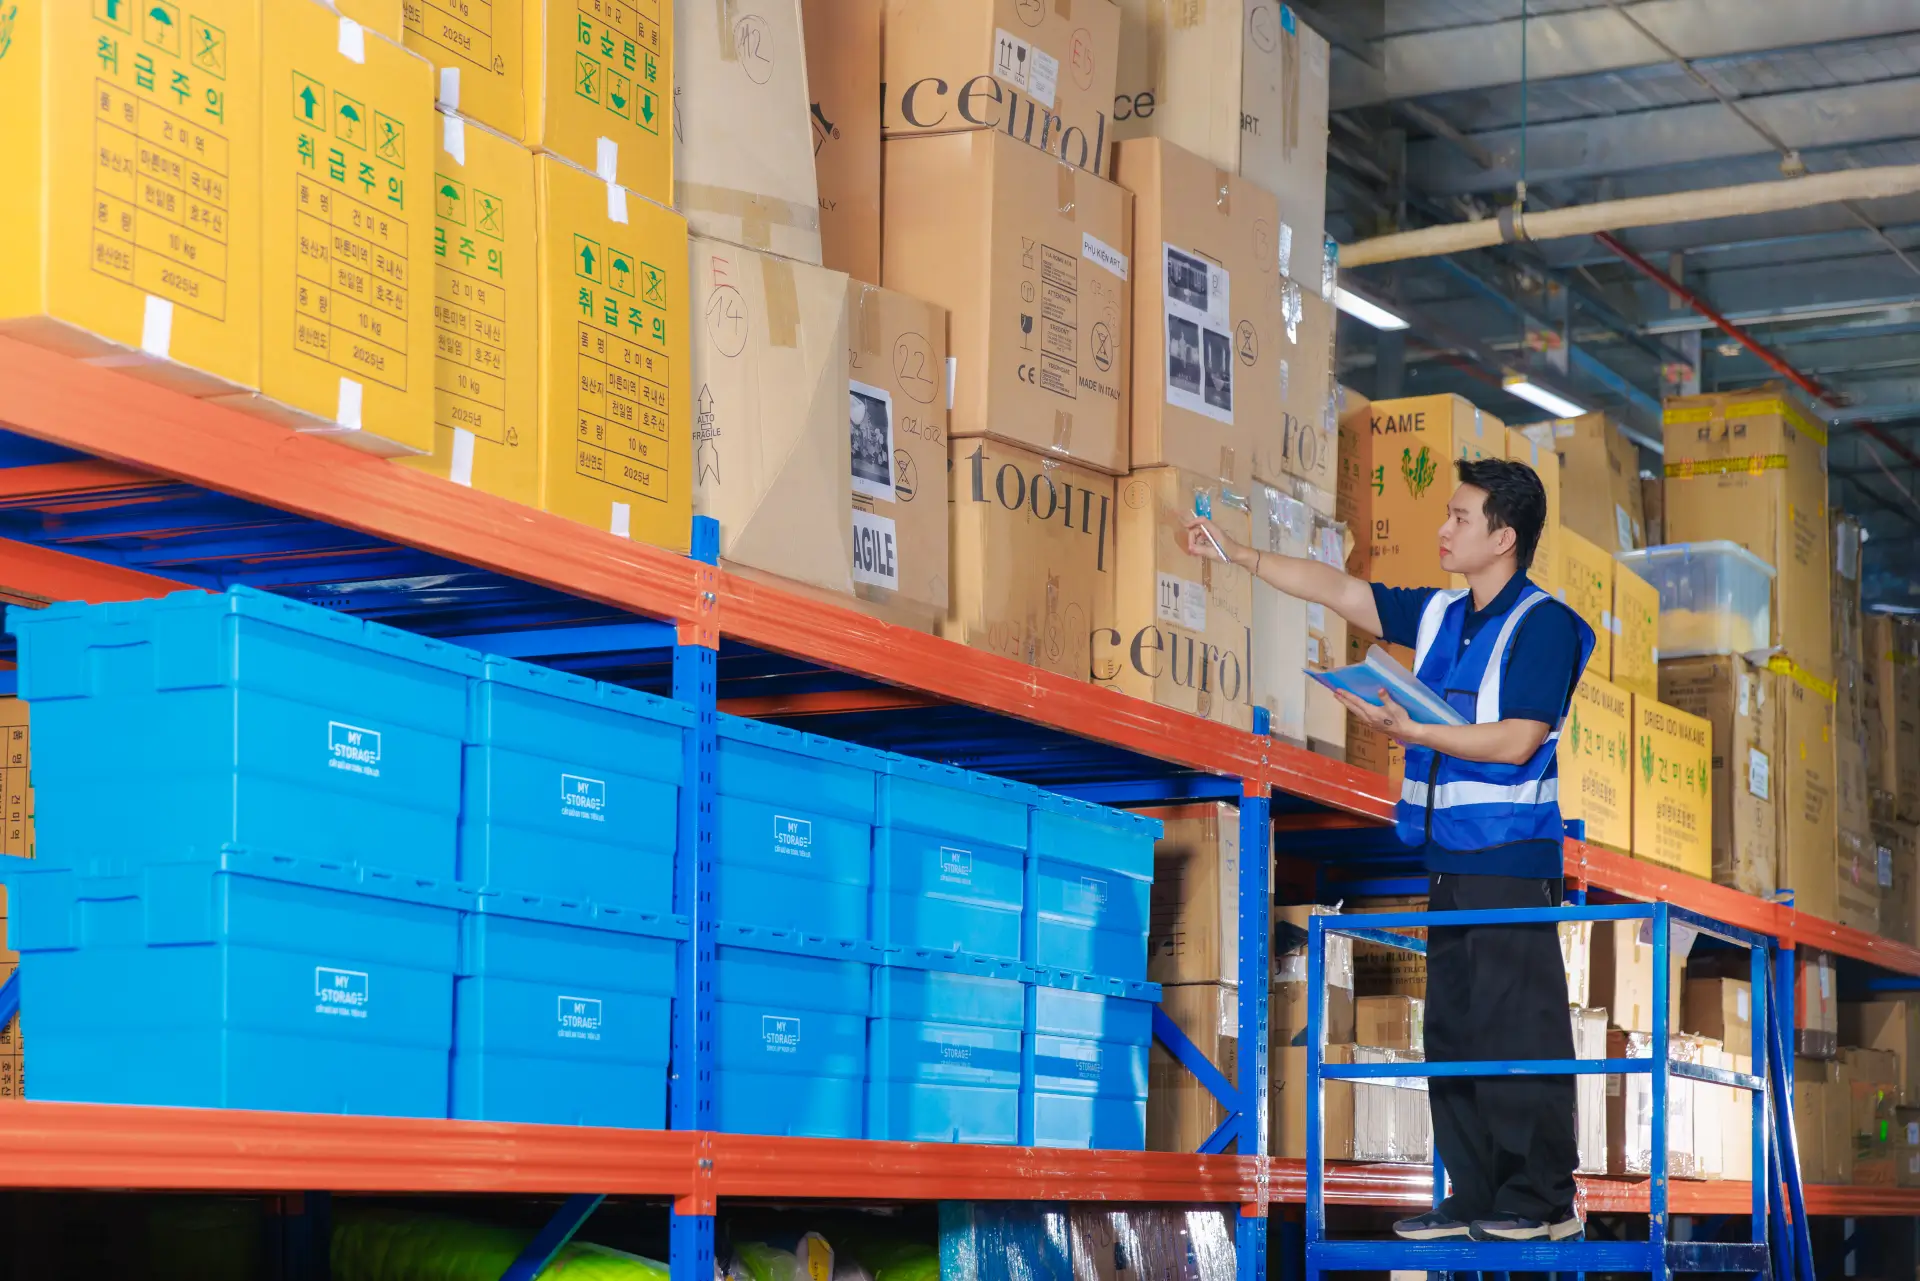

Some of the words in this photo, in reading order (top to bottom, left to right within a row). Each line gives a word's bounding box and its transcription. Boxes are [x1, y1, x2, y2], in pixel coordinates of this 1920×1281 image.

[443, 25, 471, 51] 2025년
[578, 14, 657, 83] 취급주의
[97, 36, 224, 125] 취급주의
[100, 147, 133, 178] 원산지
[298, 133, 404, 211] 취급주의
[191, 172, 222, 201] 국내산
[190, 205, 222, 234] 호주산
[169, 234, 181, 251] 10
[183, 240, 196, 260] kg
[300, 236, 329, 263] 원산지
[375, 254, 403, 281] 국내산
[712, 256, 735, 288] E
[162, 269, 199, 298] 2025년
[376, 285, 403, 310] 호주산
[358, 313, 369, 329] 10
[371, 318, 382, 336] kg
[578, 287, 666, 347] 취급주의
[706, 296, 744, 336] 14
[474, 319, 501, 343] 국내산
[352, 345, 385, 371] 2025년
[474, 347, 501, 370] 호주산
[900, 344, 933, 384] 22
[458, 374, 468, 389] 10
[470, 379, 480, 395] kg
[581, 375, 605, 399] 원산지
[609, 373, 637, 396] 마른미역
[642, 385, 665, 407] 국내산
[1079, 376, 1098, 392] MADE
[1105, 385, 1121, 401] ITALY
[451, 406, 482, 428] 2025년
[611, 400, 633, 421] 천일염
[642, 412, 665, 433] 호주산
[697, 414, 715, 424] ALTO
[692, 428, 721, 440] FRAGILE
[628, 437, 637, 451] 10
[639, 440, 648, 456] kg
[579, 451, 603, 471] 생산연도
[623, 465, 650, 487] 2025년
[347, 731, 362, 746] MY
[334, 743, 376, 764] STORAGE
[577, 782, 589, 795] MY
[566, 794, 601, 811] STORAGE
[787, 822, 798, 833] MY
[778, 832, 808, 848] STORAGE
[943, 863, 969, 875] STORAGE
[951, 853, 961, 863] MY
[335, 975, 349, 988] MY
[321, 989, 363, 1006] STORAGE
[574, 1003, 586, 1015] MY
[562, 1015, 598, 1029] STORAGE
[776, 1021, 787, 1032] MY
[766, 1033, 797, 1045] STORAGE
[943, 1049, 969, 1059] STORAGE
